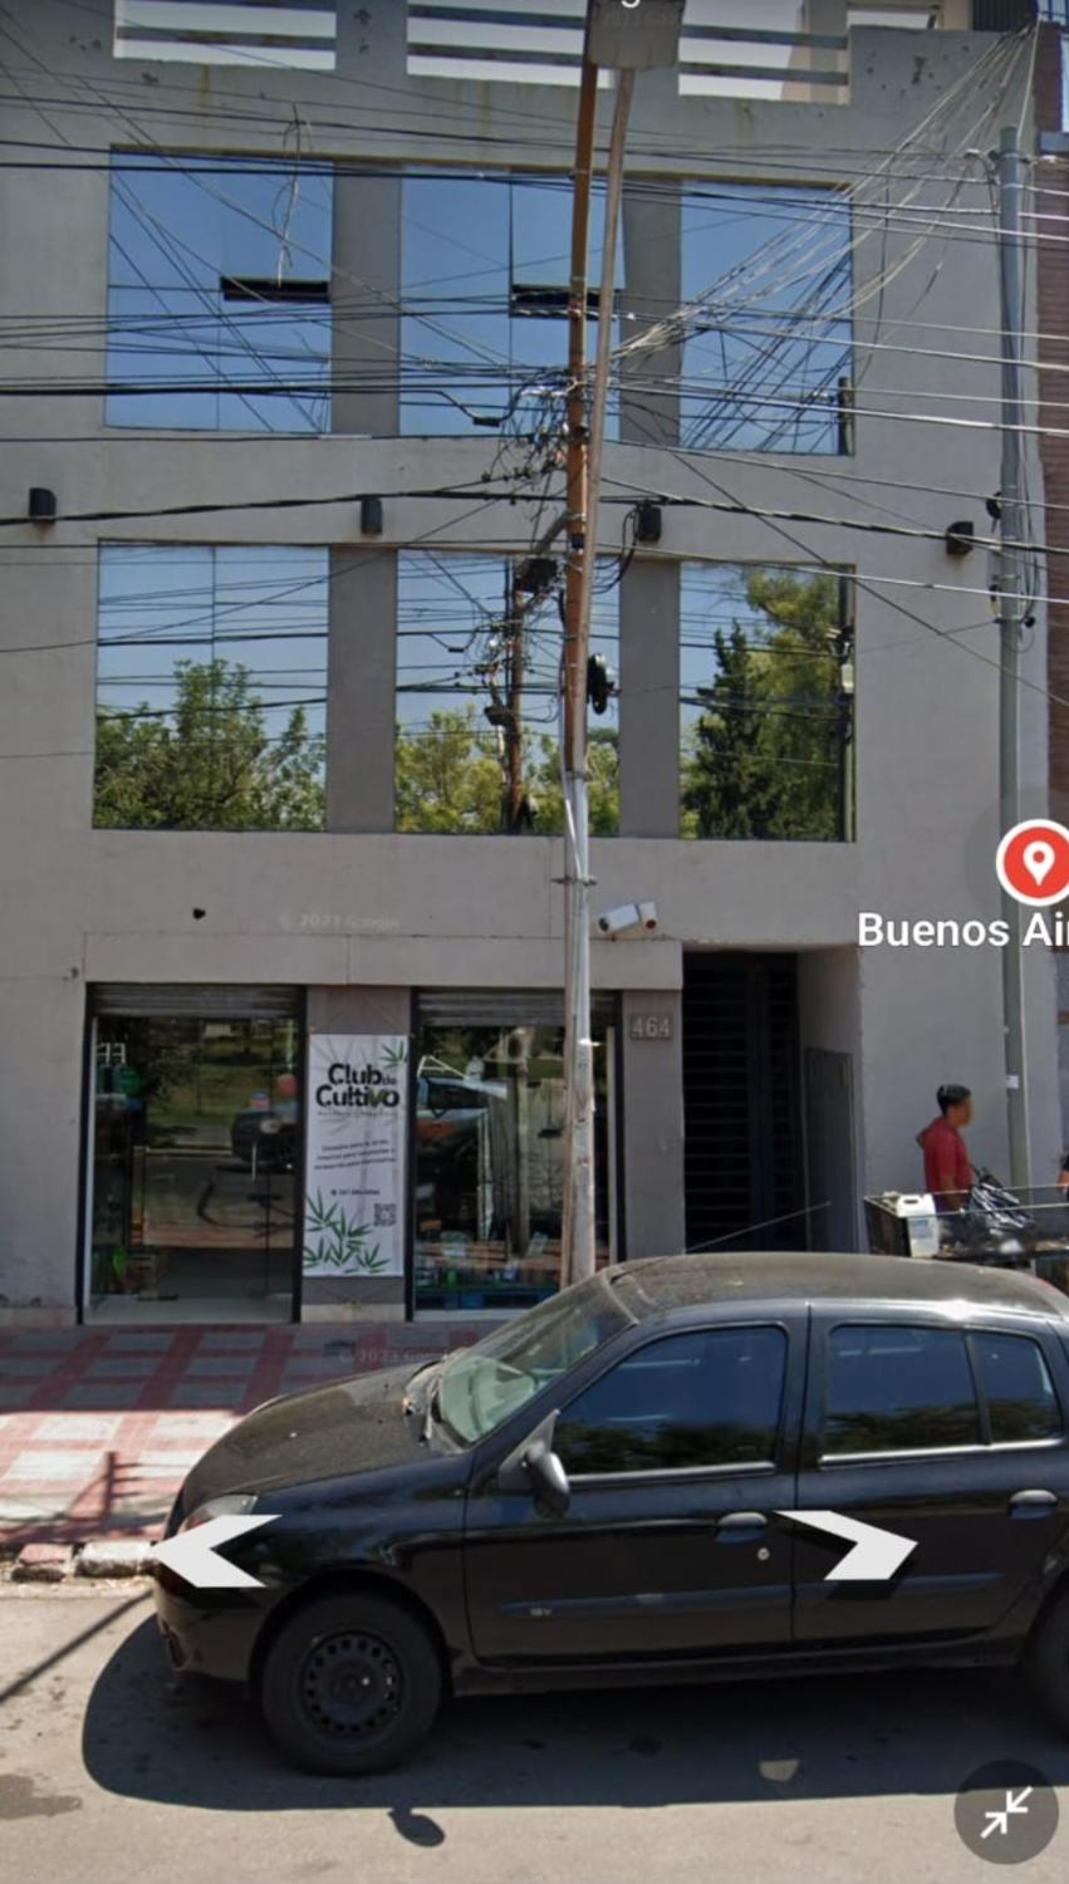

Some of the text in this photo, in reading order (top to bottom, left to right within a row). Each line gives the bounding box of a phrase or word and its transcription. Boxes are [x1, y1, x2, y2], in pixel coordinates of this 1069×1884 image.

[632, 1016, 671, 1038] 464
[327, 1063, 382, 1086] Club
[316, 1084, 399, 1108] Cultivo
